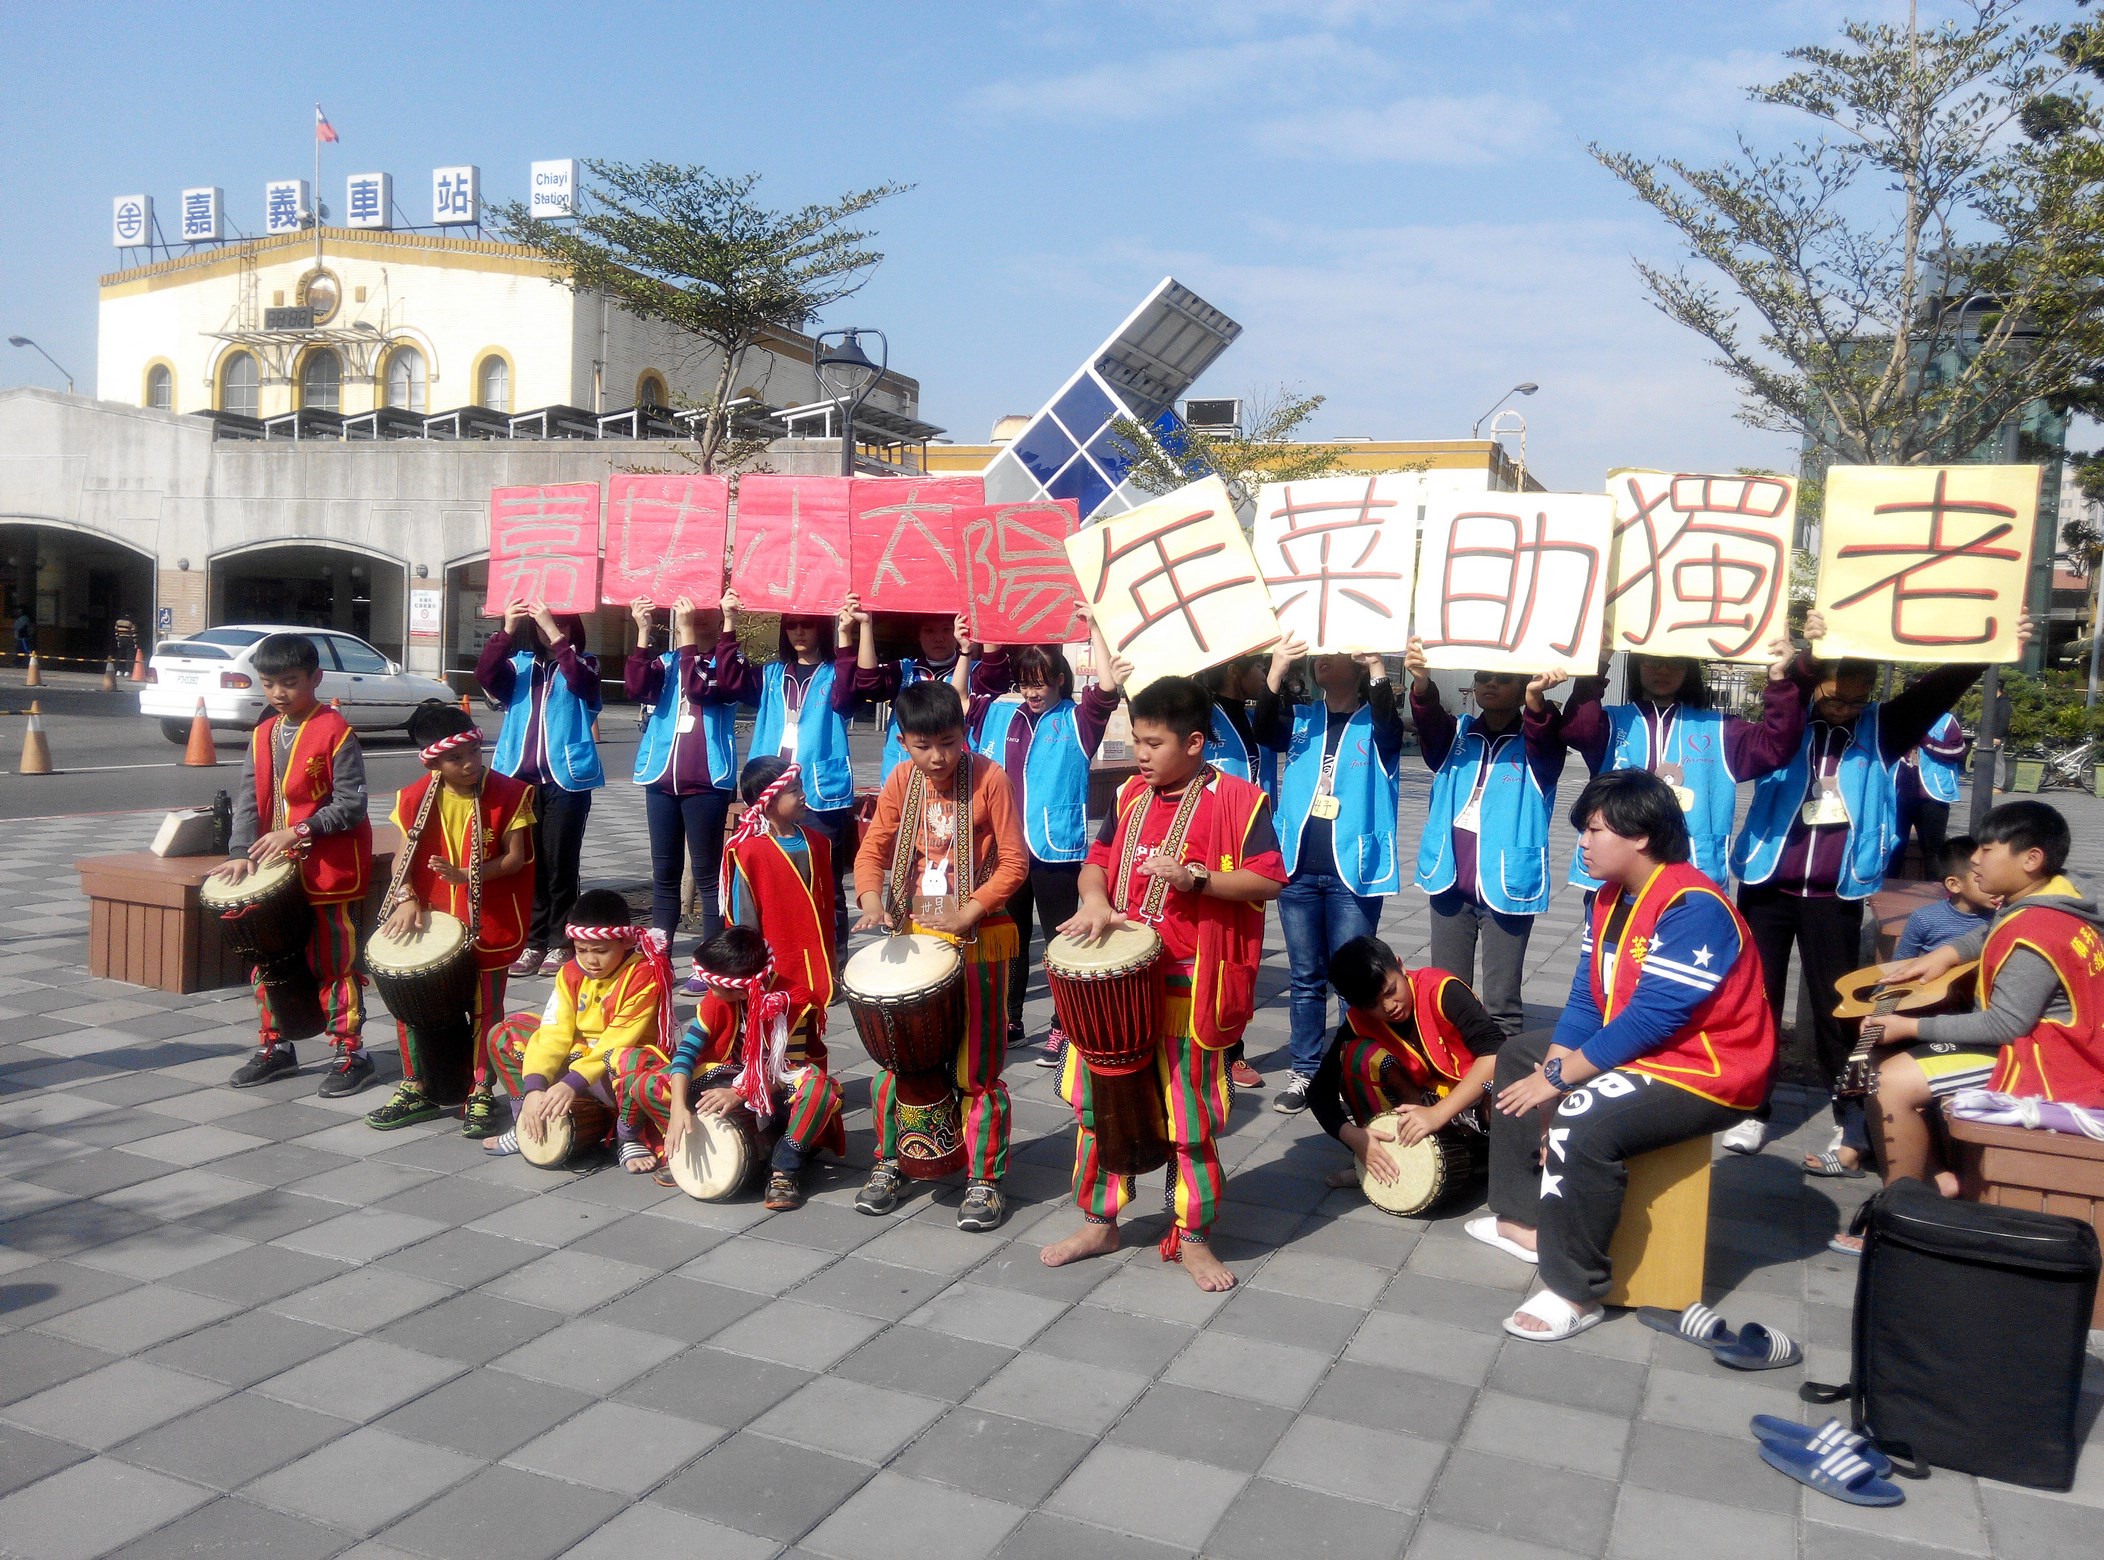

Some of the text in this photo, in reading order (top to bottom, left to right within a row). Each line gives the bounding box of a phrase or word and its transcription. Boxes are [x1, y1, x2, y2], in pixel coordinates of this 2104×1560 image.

[536, 171, 568, 187] Chiayi
[184, 172, 469, 235] 嘉義車站
[534, 192, 569, 206] Station
[305, 756, 328, 801] 華山
